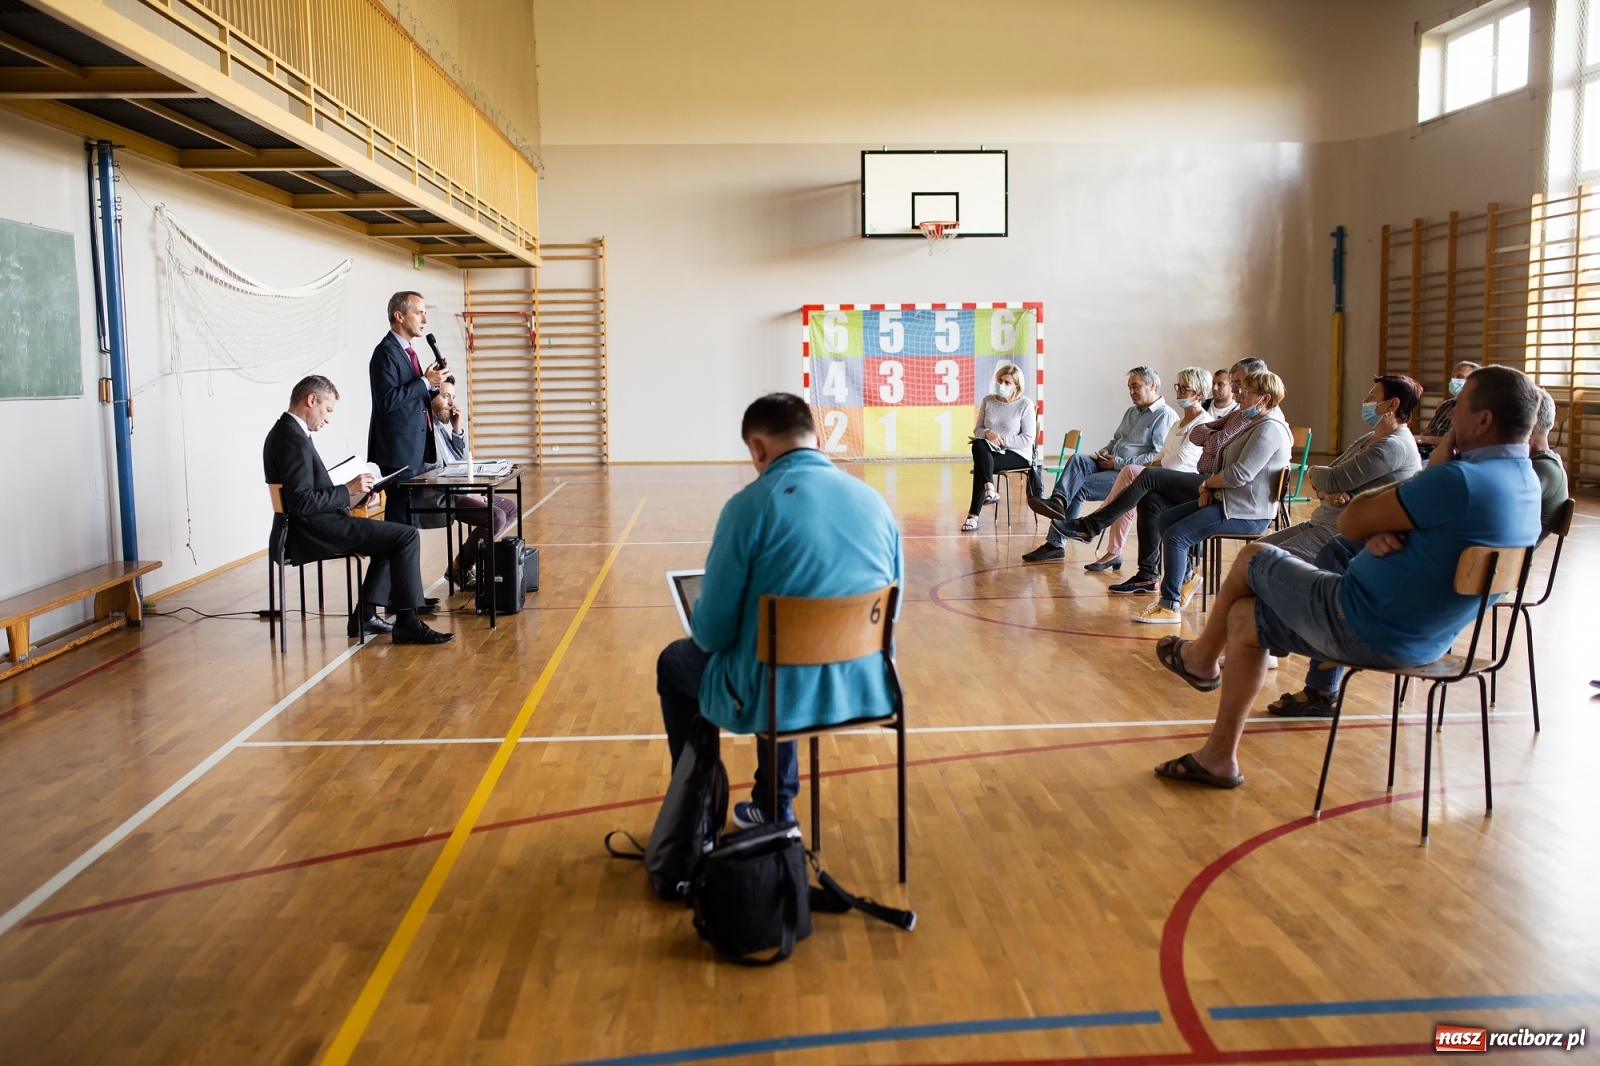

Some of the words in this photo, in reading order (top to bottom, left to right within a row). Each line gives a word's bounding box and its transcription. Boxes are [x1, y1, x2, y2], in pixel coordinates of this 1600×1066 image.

[823, 311, 849, 353] 6
[879, 311, 905, 353] 5
[935, 311, 960, 353] 5
[990, 309, 1016, 352] 6
[823, 361, 849, 403] 4
[879, 360, 904, 403] 3
[934, 360, 960, 403] 3
[824, 410, 848, 453] 2
[879, 411, 897, 452] 1
[934, 410, 953, 452] 1
[870, 598, 881, 624] 6
